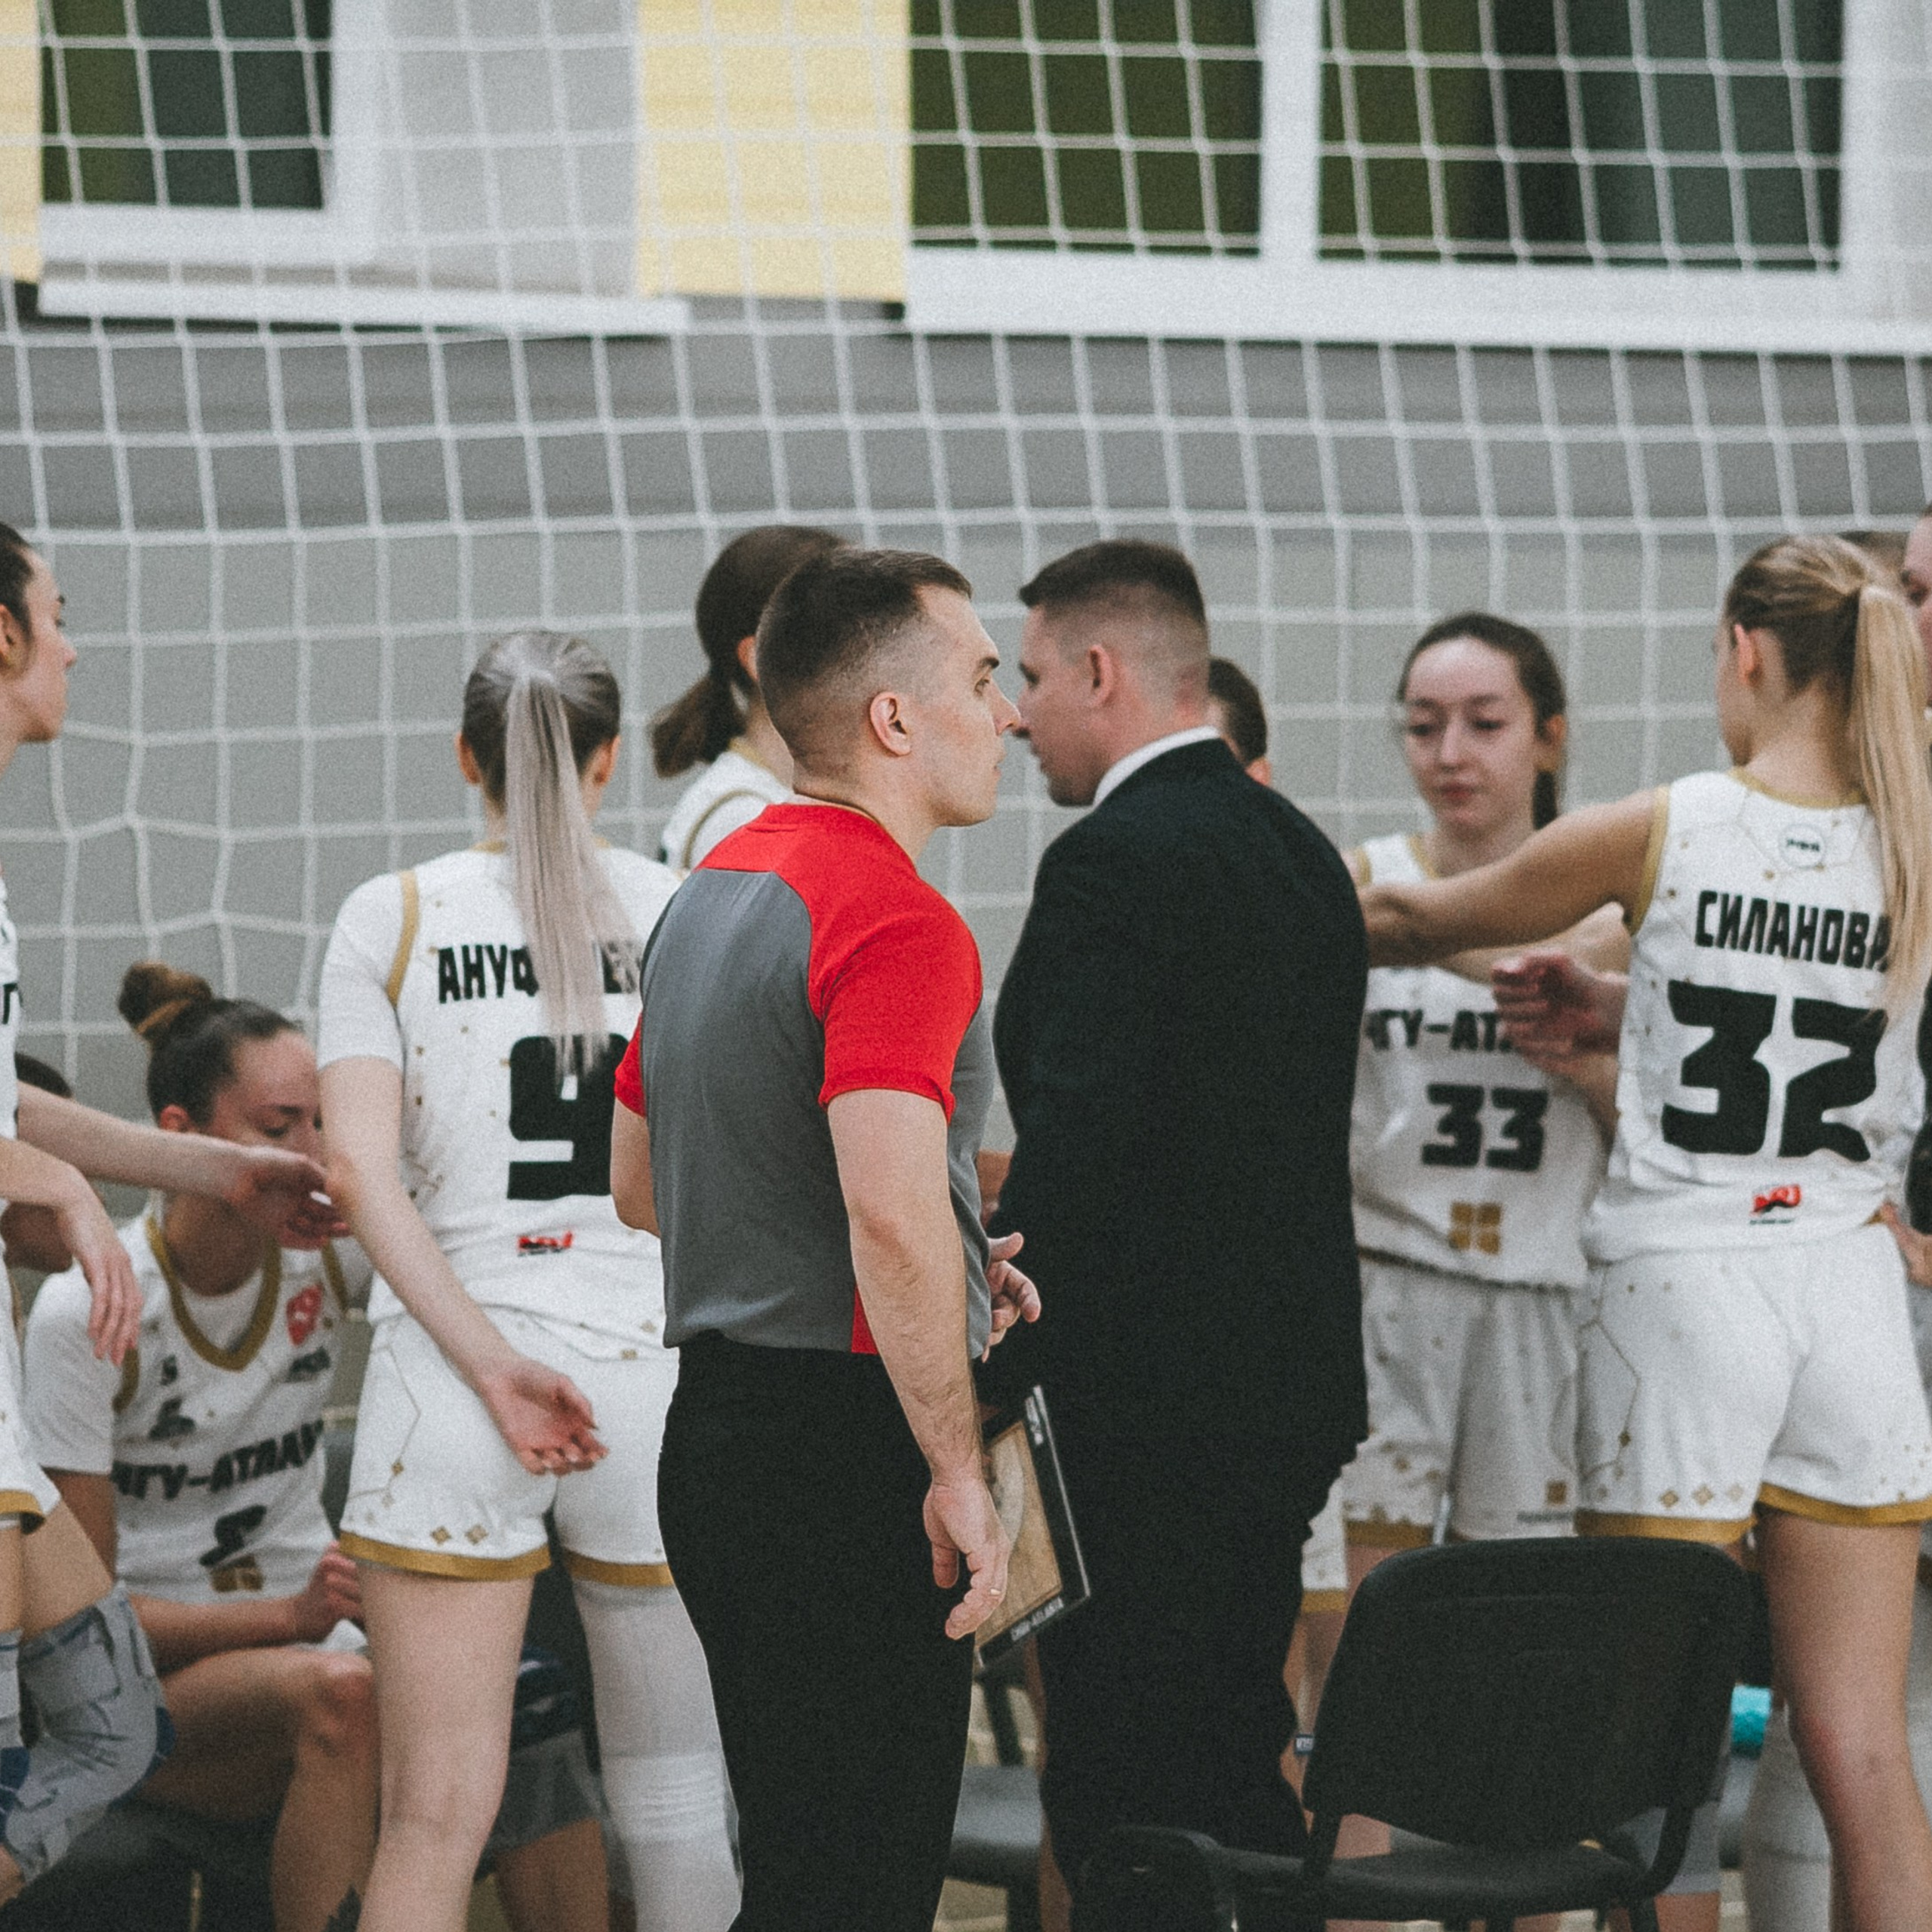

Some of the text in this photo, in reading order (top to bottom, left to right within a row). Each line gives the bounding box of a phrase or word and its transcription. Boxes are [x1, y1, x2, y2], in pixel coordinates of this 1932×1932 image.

[1695, 890, 1892, 973] СИЛАНОВА
[508, 1033, 629, 1201] 9
[1421, 1083, 1549, 1172] 33
[1661, 980, 1888, 1162] 32
